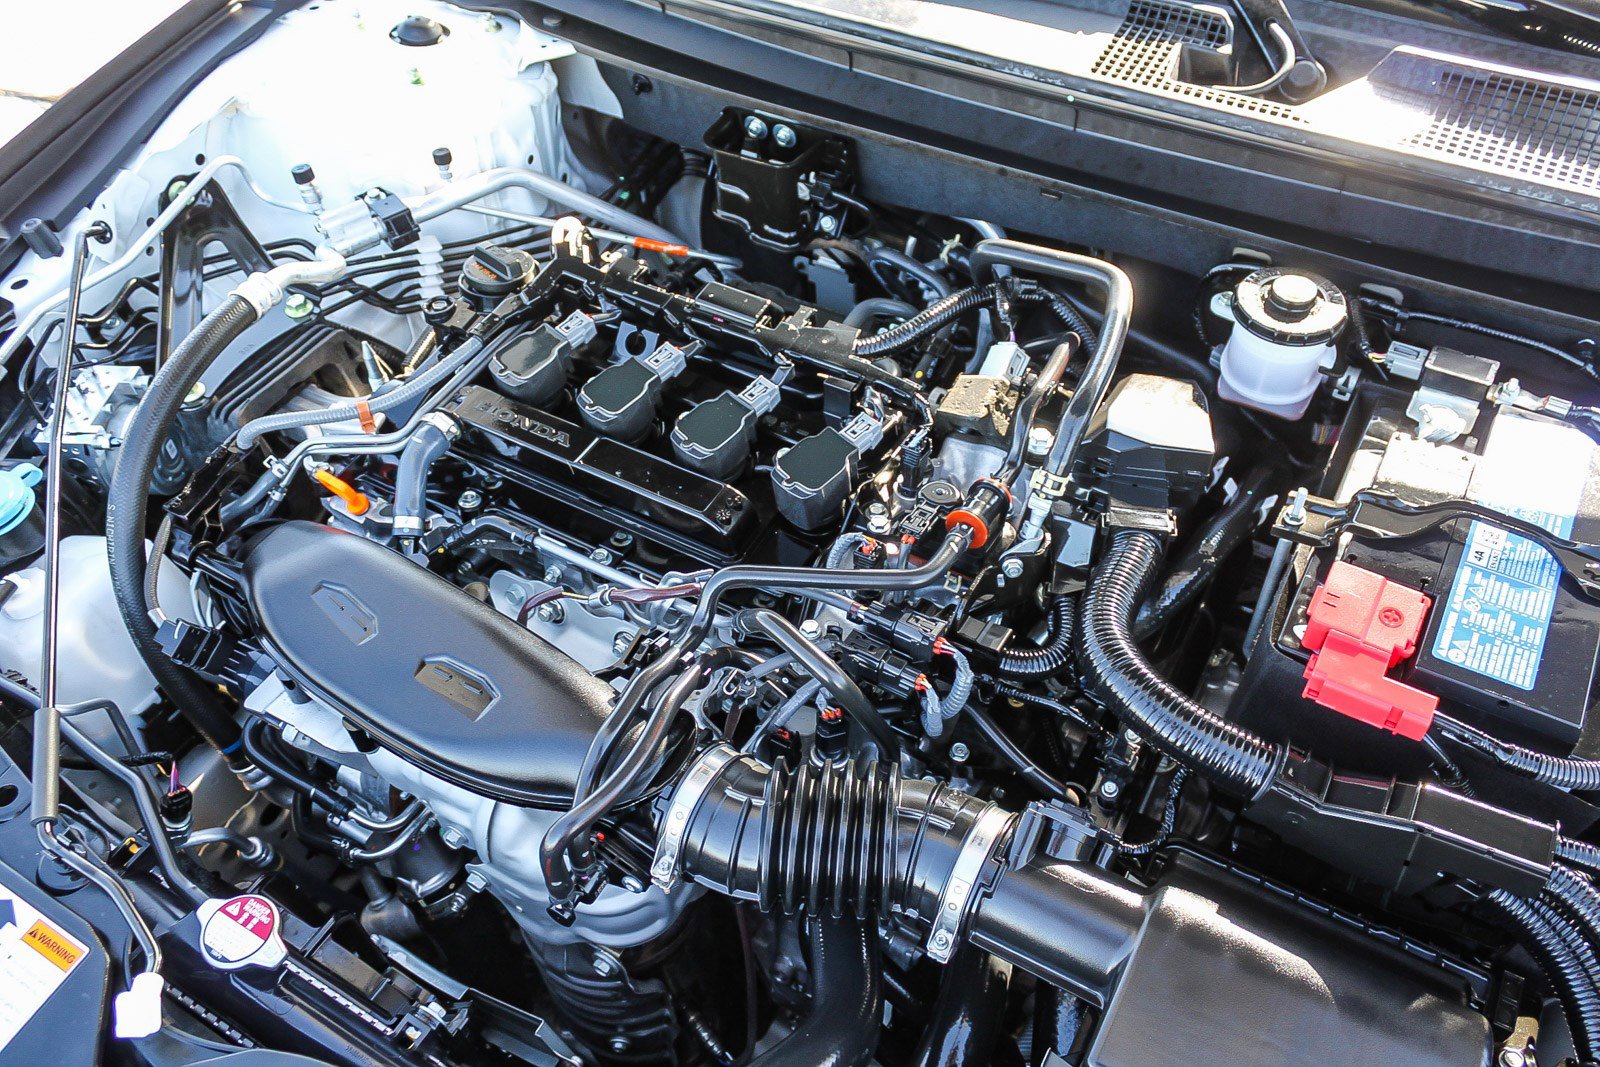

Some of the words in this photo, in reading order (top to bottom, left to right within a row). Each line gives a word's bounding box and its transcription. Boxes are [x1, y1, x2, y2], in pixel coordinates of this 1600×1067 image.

[475, 402, 570, 448] HONDA
[1474, 550, 1485, 562] 4A
[37, 932, 76, 964] WARNING
